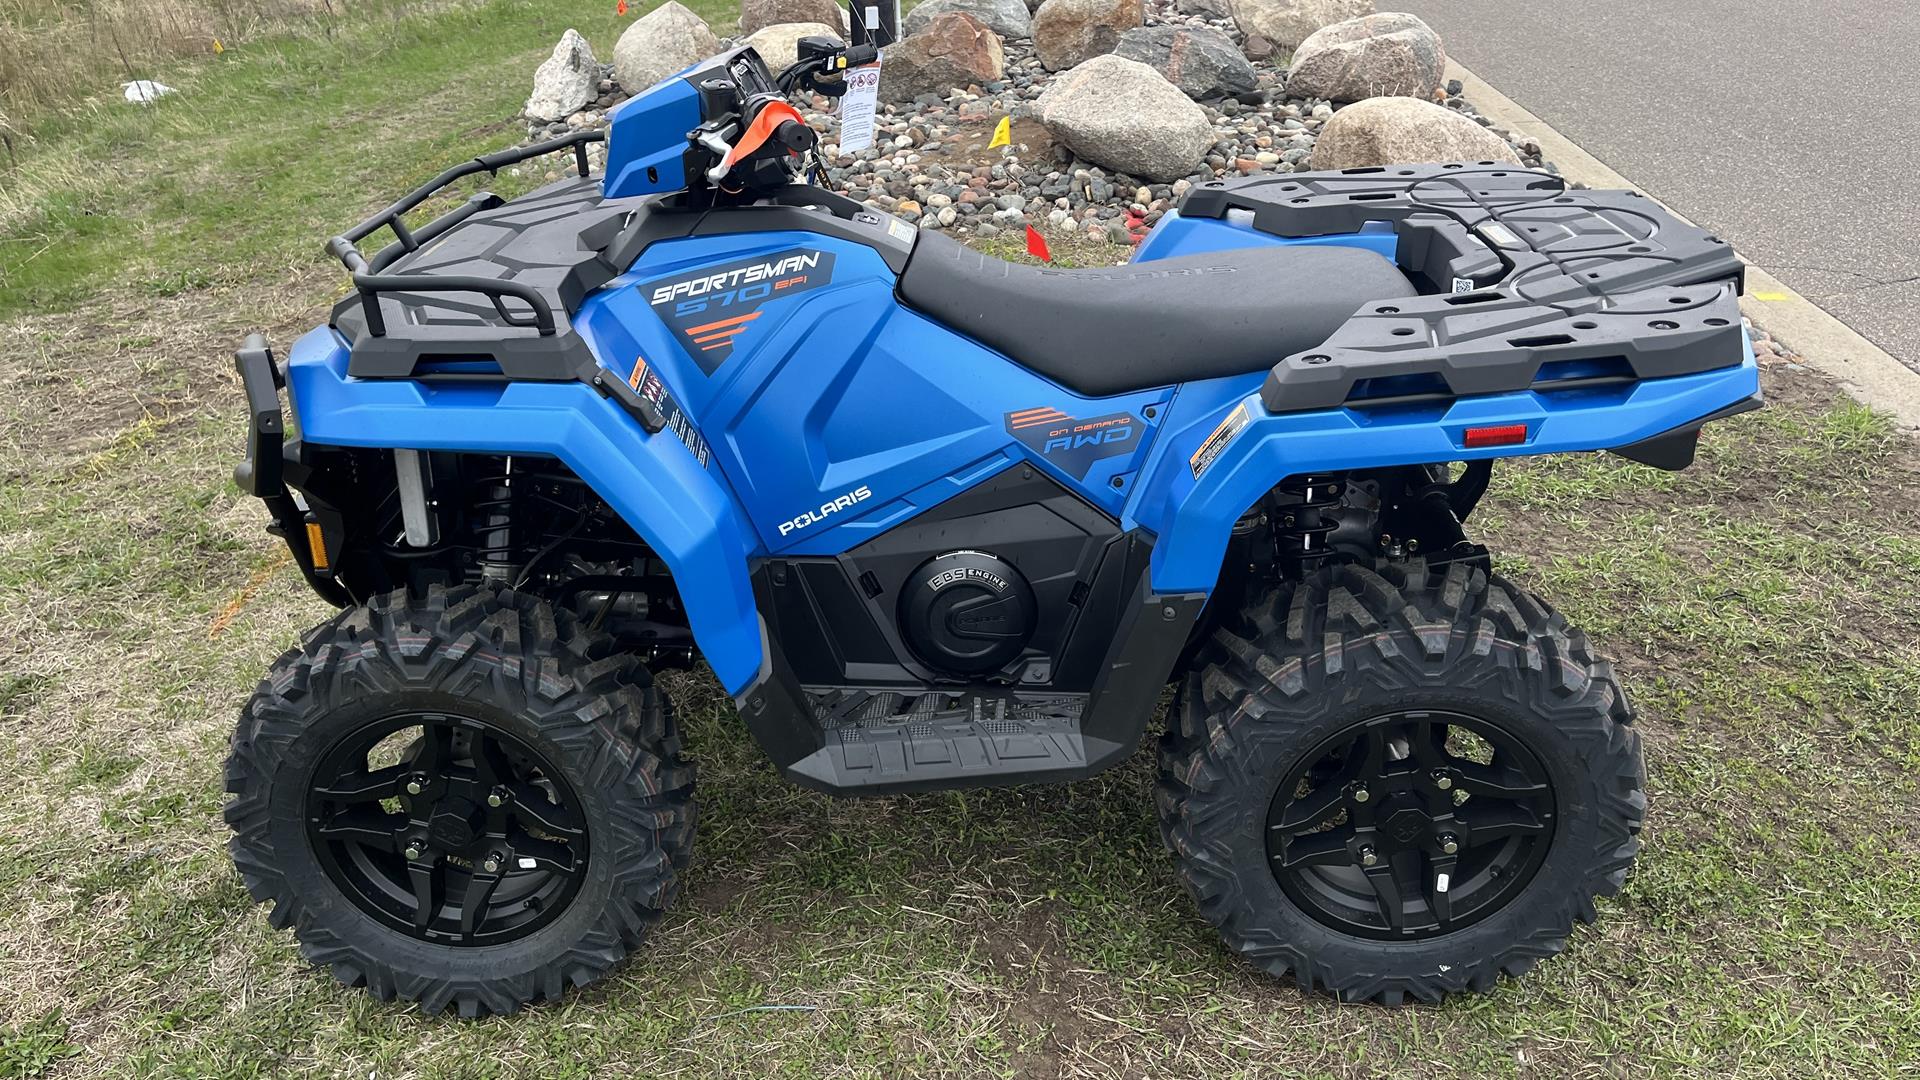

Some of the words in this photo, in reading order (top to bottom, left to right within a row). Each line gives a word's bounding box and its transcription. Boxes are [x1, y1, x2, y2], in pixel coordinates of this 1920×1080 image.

[651, 252, 820, 305] SPORTSMAN
[675, 282, 771, 318] 570
[774, 275, 808, 290] EFI
[1044, 427, 1132, 454] AWD
[1049, 428, 1069, 437] ON
[1074, 417, 1130, 432] DEMAND
[778, 485, 872, 536] POLARIS
[931, 568, 964, 588] EBS
[968, 569, 1007, 588] ENGINE
